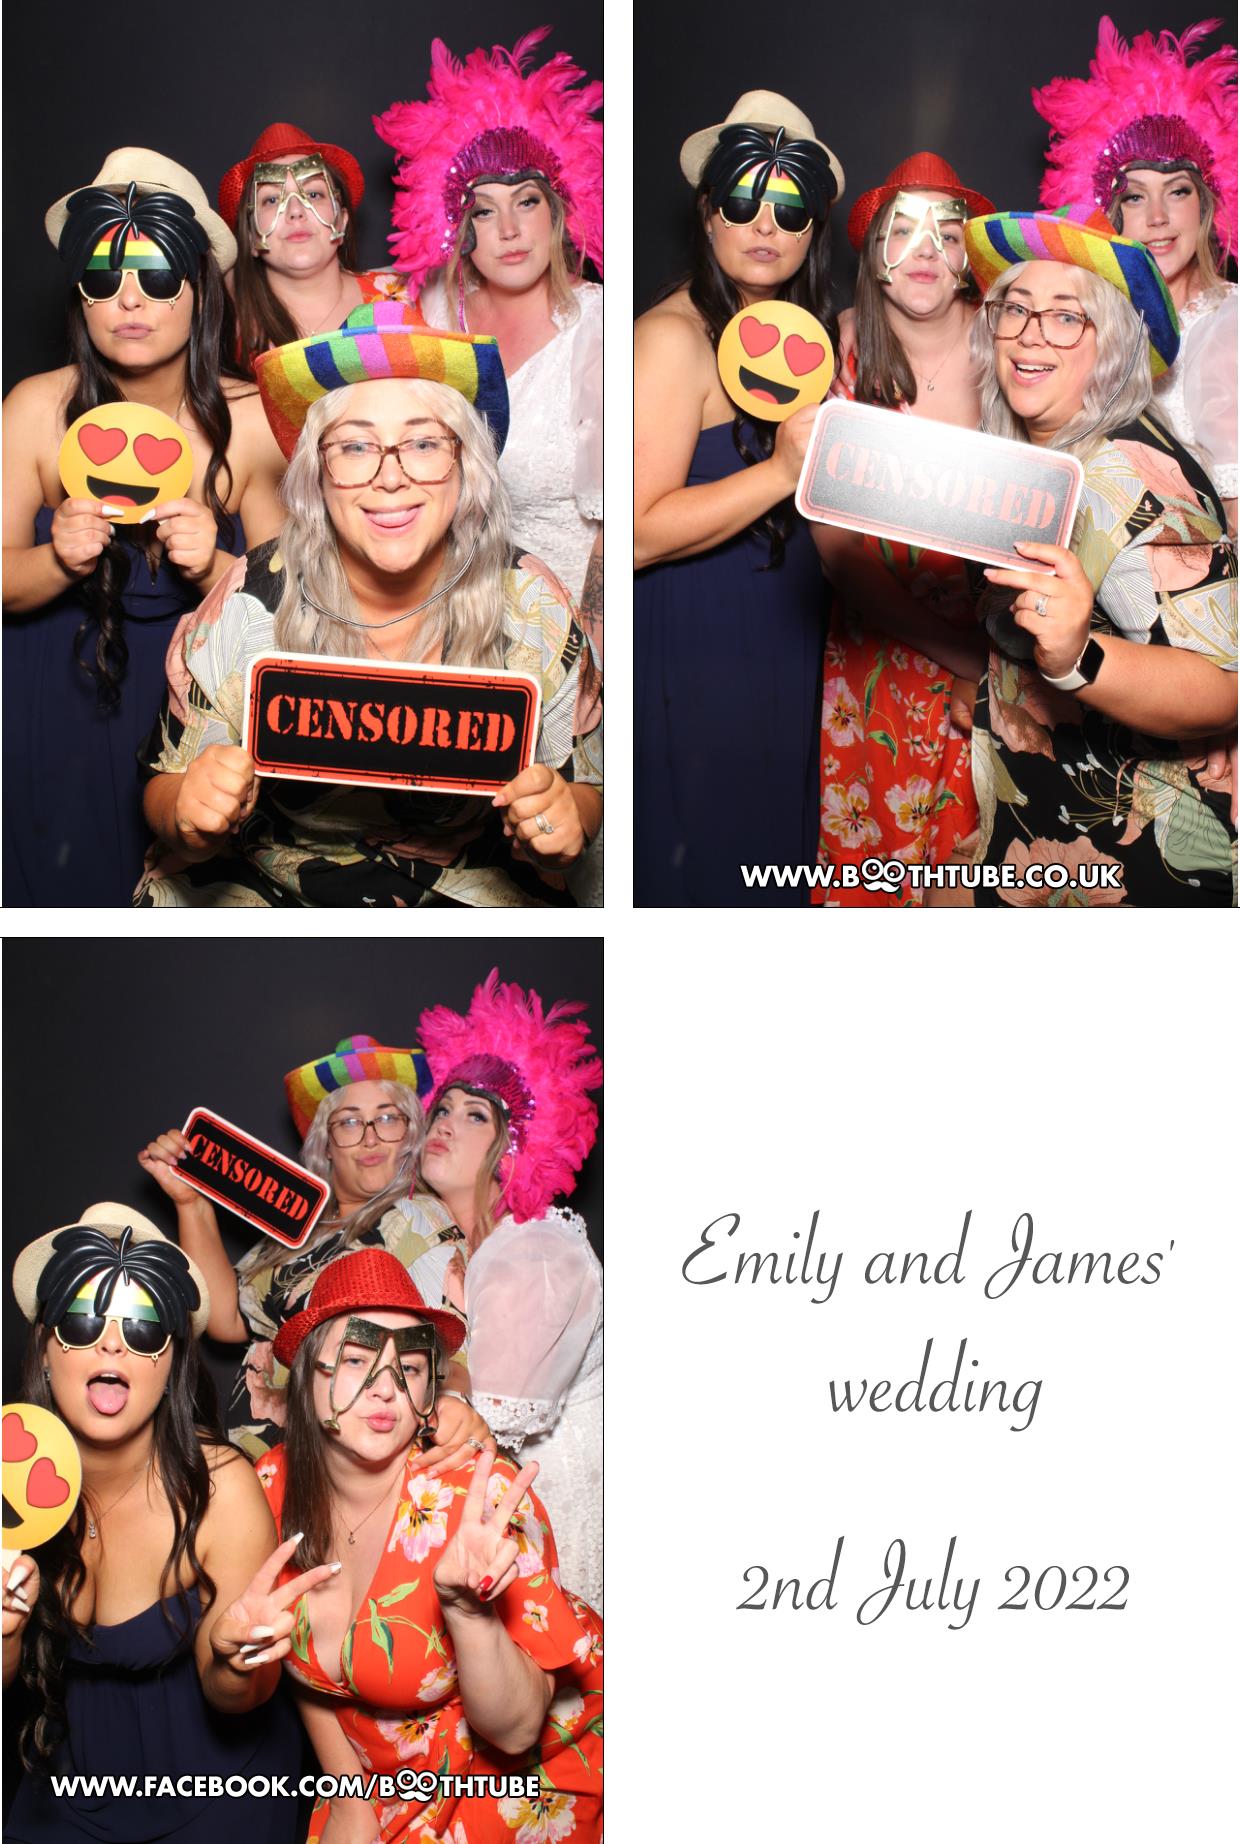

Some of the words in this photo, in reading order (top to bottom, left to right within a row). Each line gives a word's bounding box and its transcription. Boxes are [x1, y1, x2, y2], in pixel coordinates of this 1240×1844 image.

[826, 441, 1056, 529] CENSORED
[266, 694, 516, 752] CENSORED
[189, 1133, 309, 1221] CENSORED
